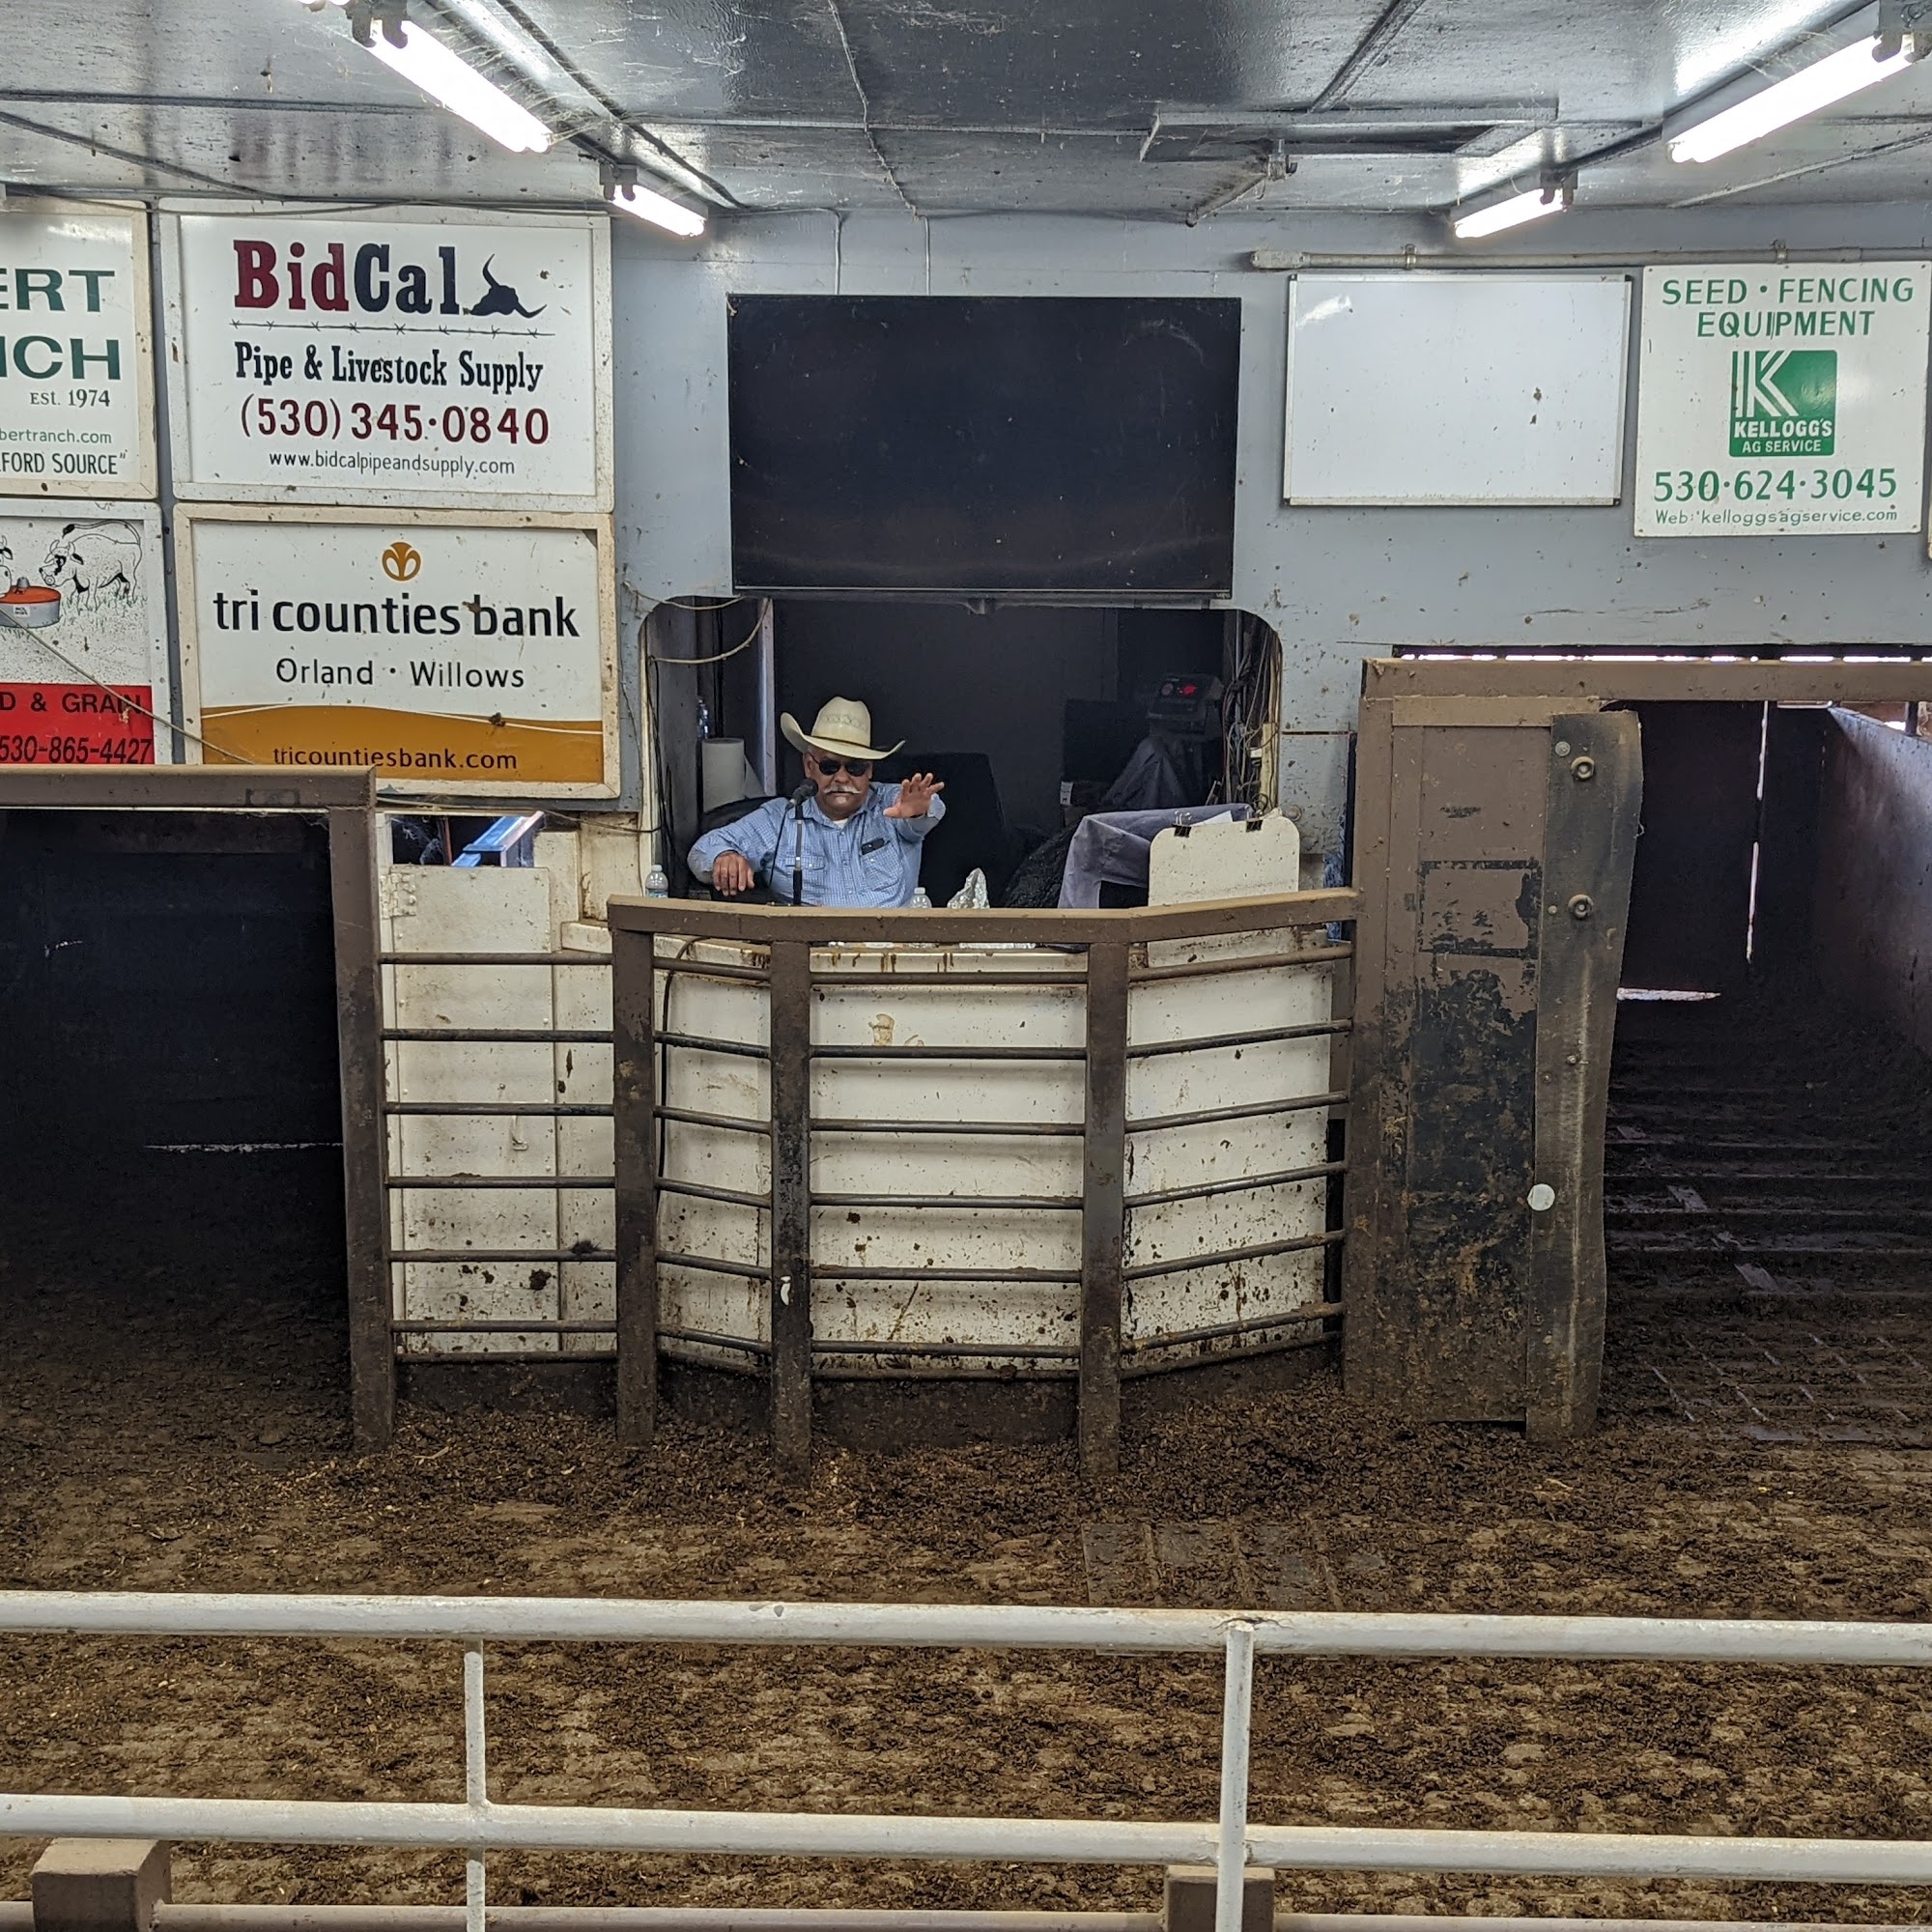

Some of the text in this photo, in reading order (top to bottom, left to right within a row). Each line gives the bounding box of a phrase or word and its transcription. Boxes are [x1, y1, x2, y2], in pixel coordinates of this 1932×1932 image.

[0, 269, 115, 312] RT
[233, 240, 460, 315] BidCal
[1662, 277, 1914, 305] SEED FENCING
[1696, 310, 1875, 337] EQUIPMENT
[0, 335, 121, 380] CH
[235, 341, 544, 395] Pipe & Livestock Supply
[68, 388, 111, 408] 1974
[242, 393, 341, 440] (530)
[1734, 418, 1833, 438] KELLOGG'S
[1742, 440, 1822, 453] AG SERVICE
[0, 452, 45, 473] FORD
[270, 450, 515, 478] www.bidcalpipeandsupply.com
[1701, 507, 1898, 526] kelloggsagservice.com
[213, 589, 580, 638] tri counties bank
[276, 658, 525, 687] Orland Willows
[31, 692, 47, 712] &
[62, 693, 143, 714] GRAIN
[274, 747, 517, 769] tricountiesbank.com
